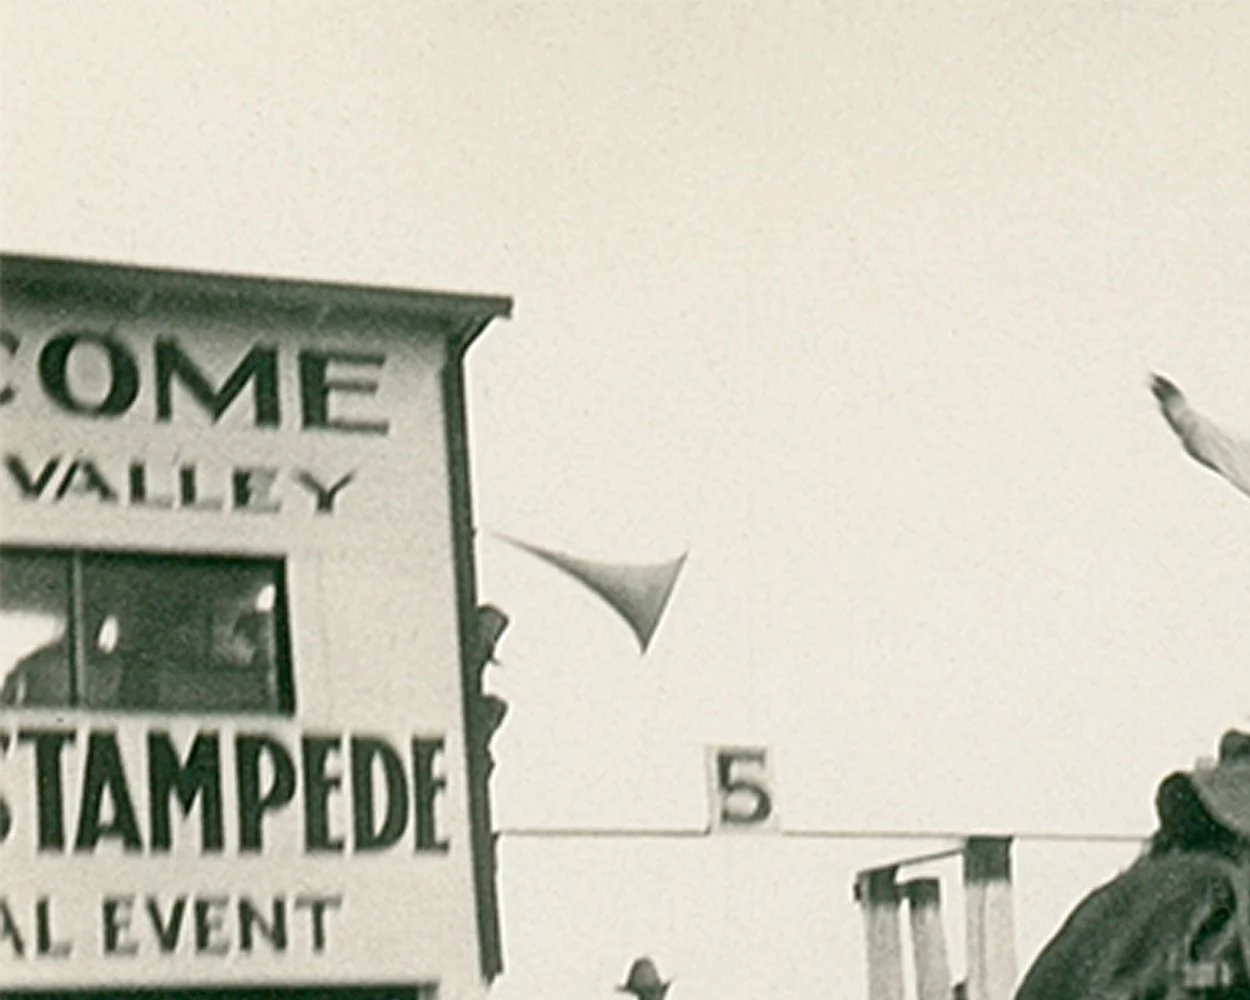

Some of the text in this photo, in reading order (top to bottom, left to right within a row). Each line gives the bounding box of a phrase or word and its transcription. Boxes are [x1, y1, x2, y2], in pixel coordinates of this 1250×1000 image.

[0, 328, 389, 436] OME
[3, 451, 356, 516] VALLEY
[0, 727, 450, 855] TAMPEDE
[716, 746, 772, 826] 5
[101, 893, 343, 957] EVENT
